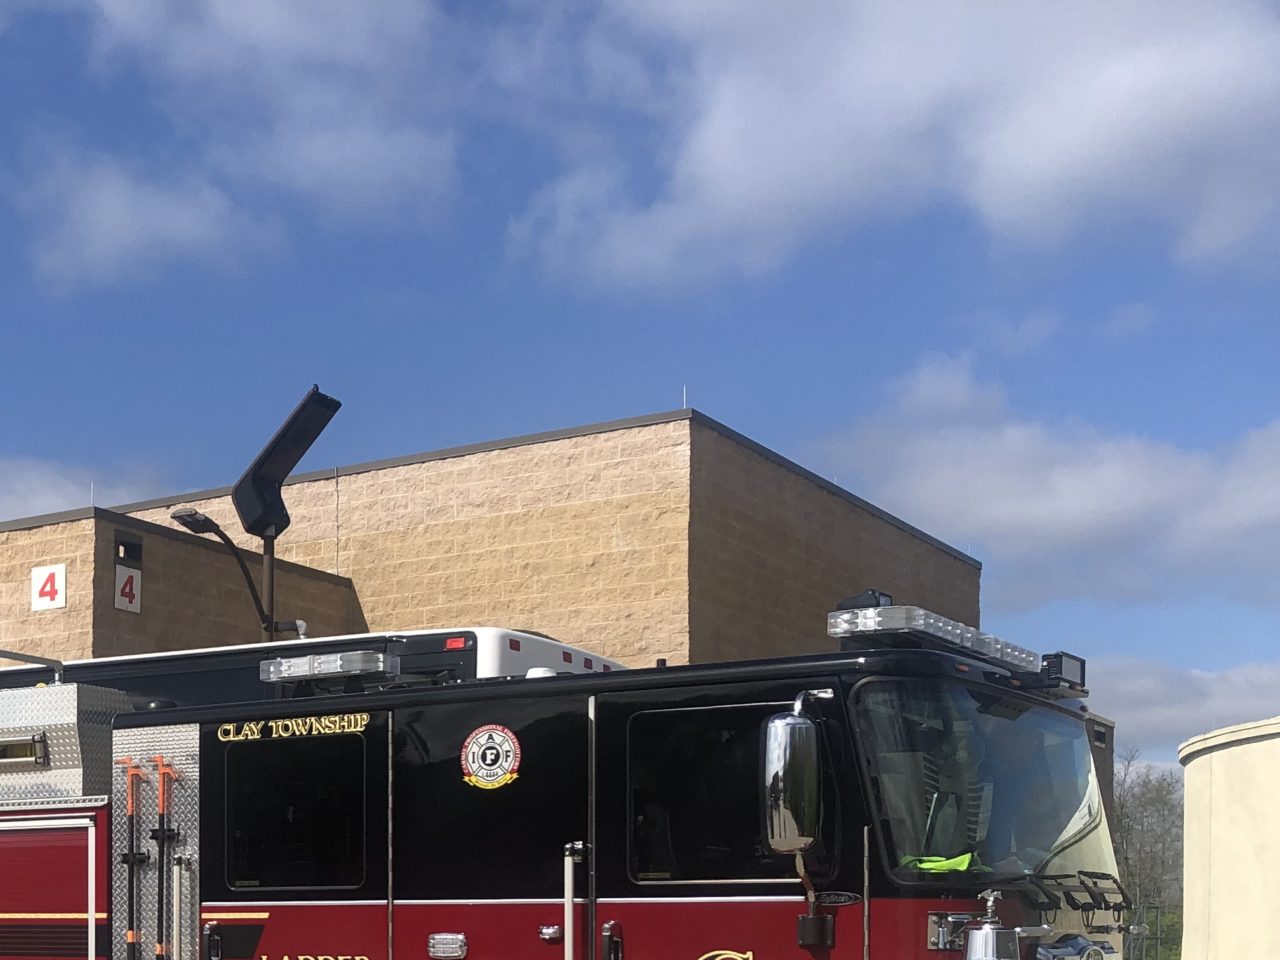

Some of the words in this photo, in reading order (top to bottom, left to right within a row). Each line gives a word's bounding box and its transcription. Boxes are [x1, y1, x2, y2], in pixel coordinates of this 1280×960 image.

[38, 572, 58, 601] 4
[120, 575, 135, 604] 4
[218, 721, 264, 741] CLAY
[268, 713, 370, 737] TOWNSHIP
